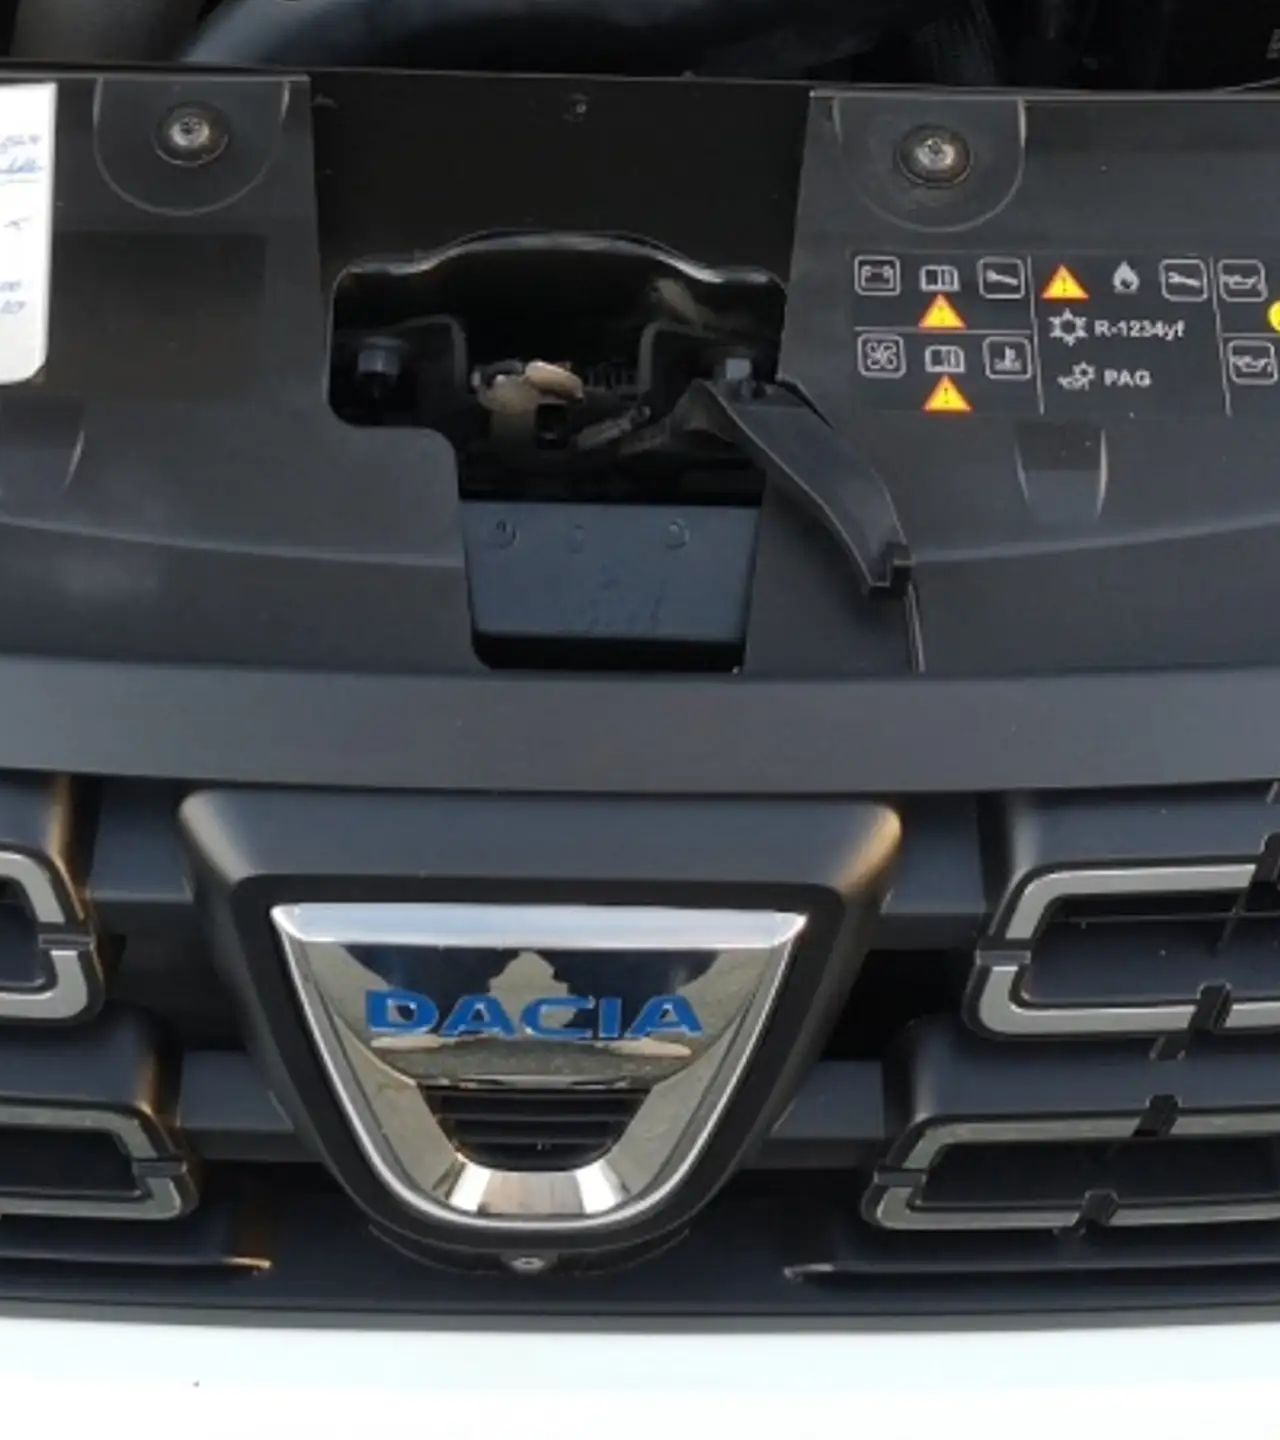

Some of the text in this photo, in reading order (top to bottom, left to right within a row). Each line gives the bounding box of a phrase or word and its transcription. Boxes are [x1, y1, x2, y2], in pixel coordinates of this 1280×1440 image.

[1094, 319, 1186, 341] R-1234yf
[1103, 368, 1152, 389] PAG
[364, 987, 705, 1042] DACIA
